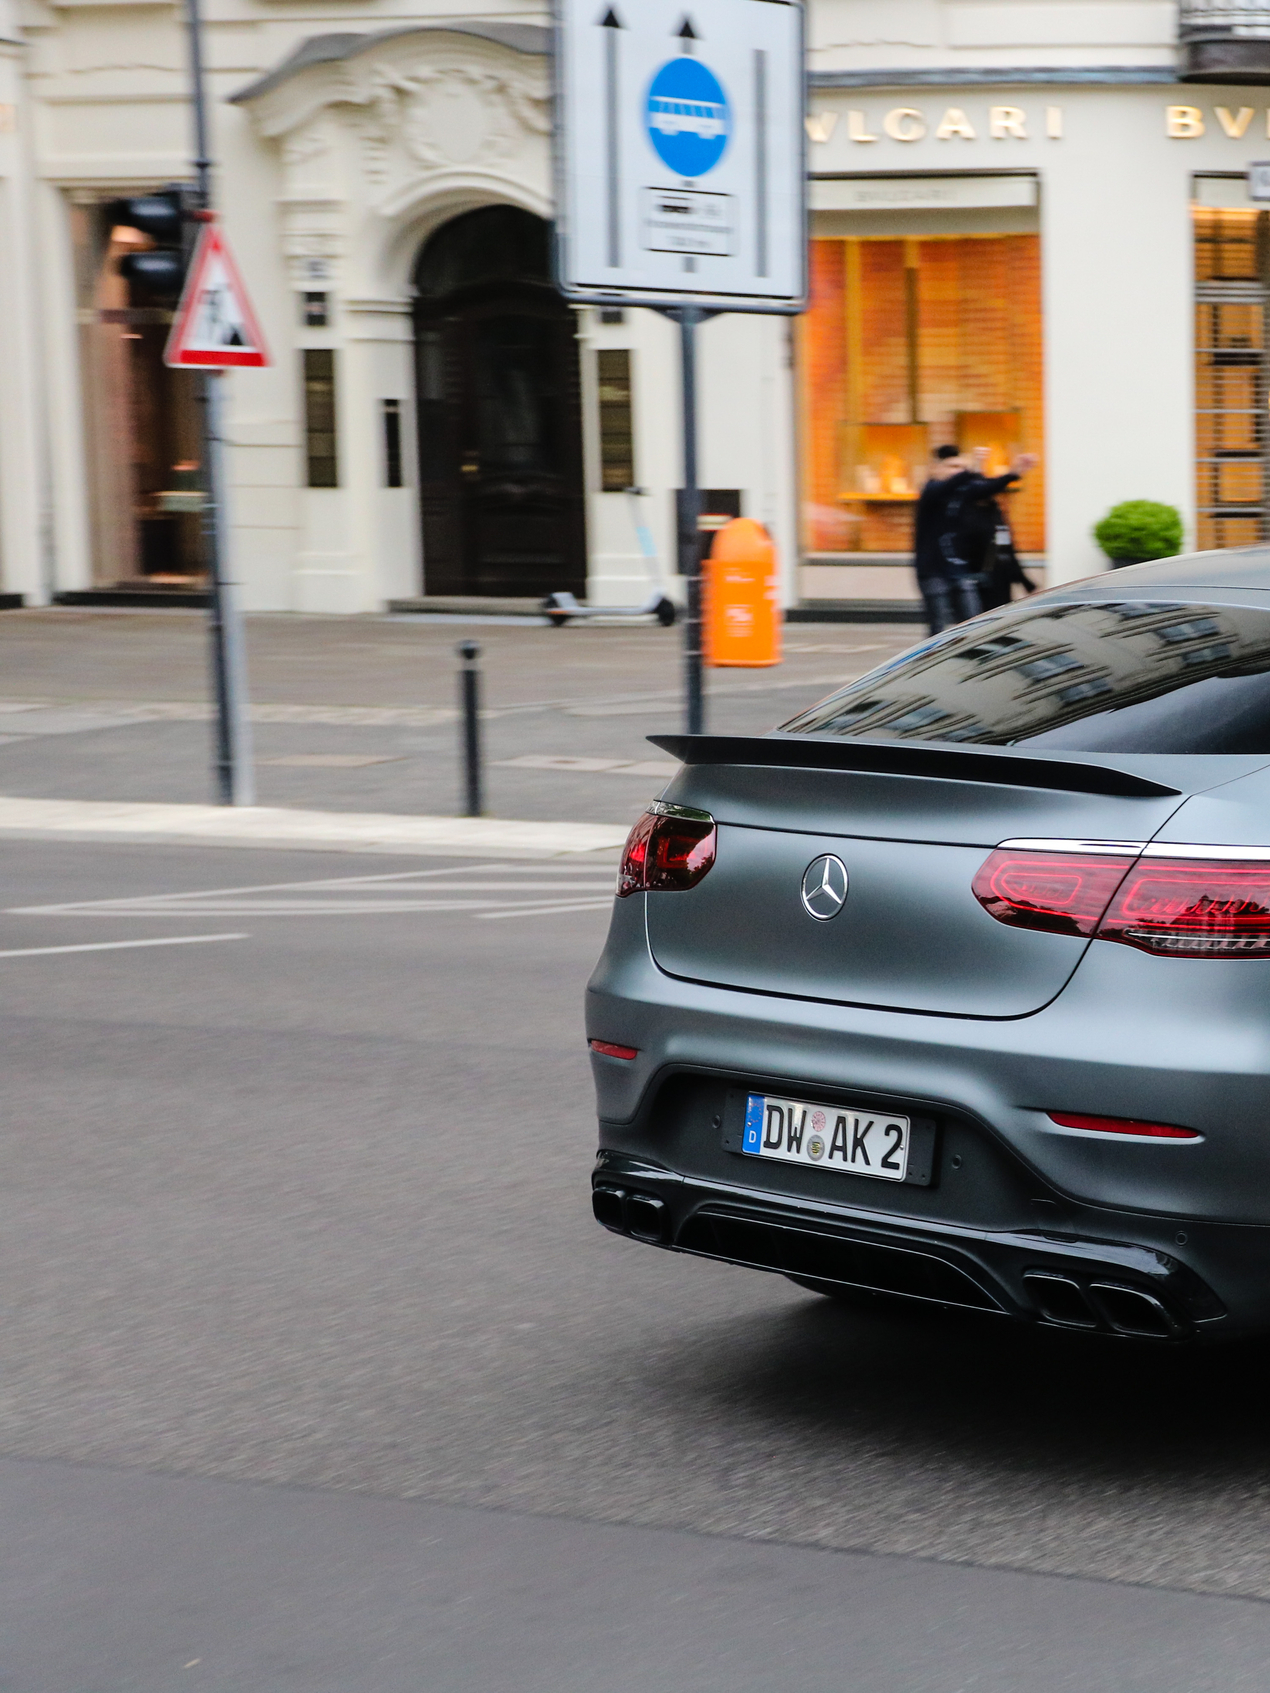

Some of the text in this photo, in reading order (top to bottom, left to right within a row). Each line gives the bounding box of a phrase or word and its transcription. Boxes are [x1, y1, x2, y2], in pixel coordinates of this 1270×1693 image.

[804, 106, 1063, 142] VLGARI
[749, 1130, 757, 1143] D
[763, 1105, 903, 1170] DW AK 2
